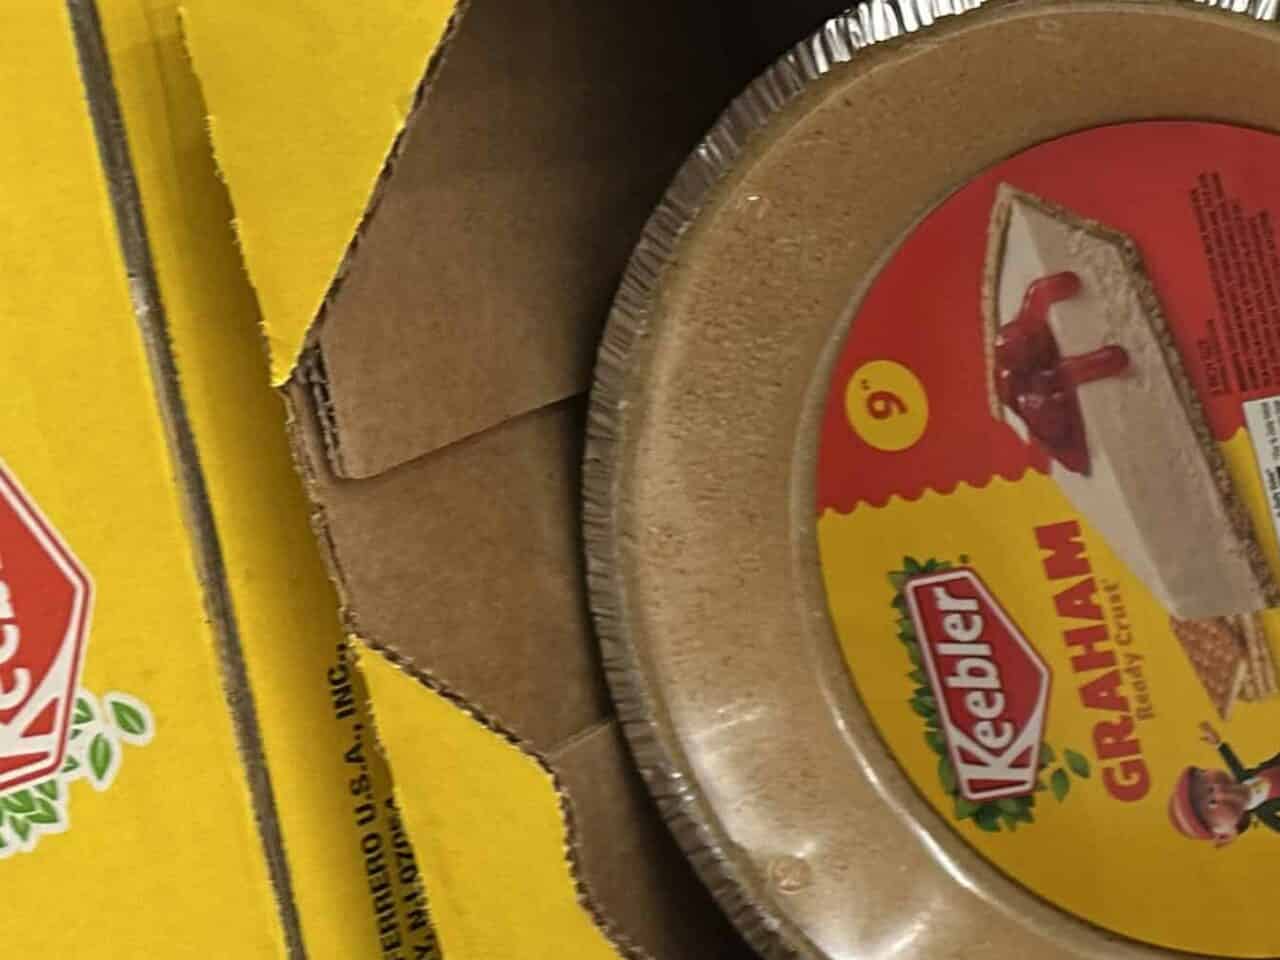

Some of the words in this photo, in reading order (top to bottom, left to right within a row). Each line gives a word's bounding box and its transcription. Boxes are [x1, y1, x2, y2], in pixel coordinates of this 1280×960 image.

[862, 378, 908, 418] 9"
[1102, 579, 1142, 644] Crust
[937, 586, 1037, 797] Keebler
[1033, 520, 1151, 803] GRAHAM
[1123, 651, 1157, 722] Ready
